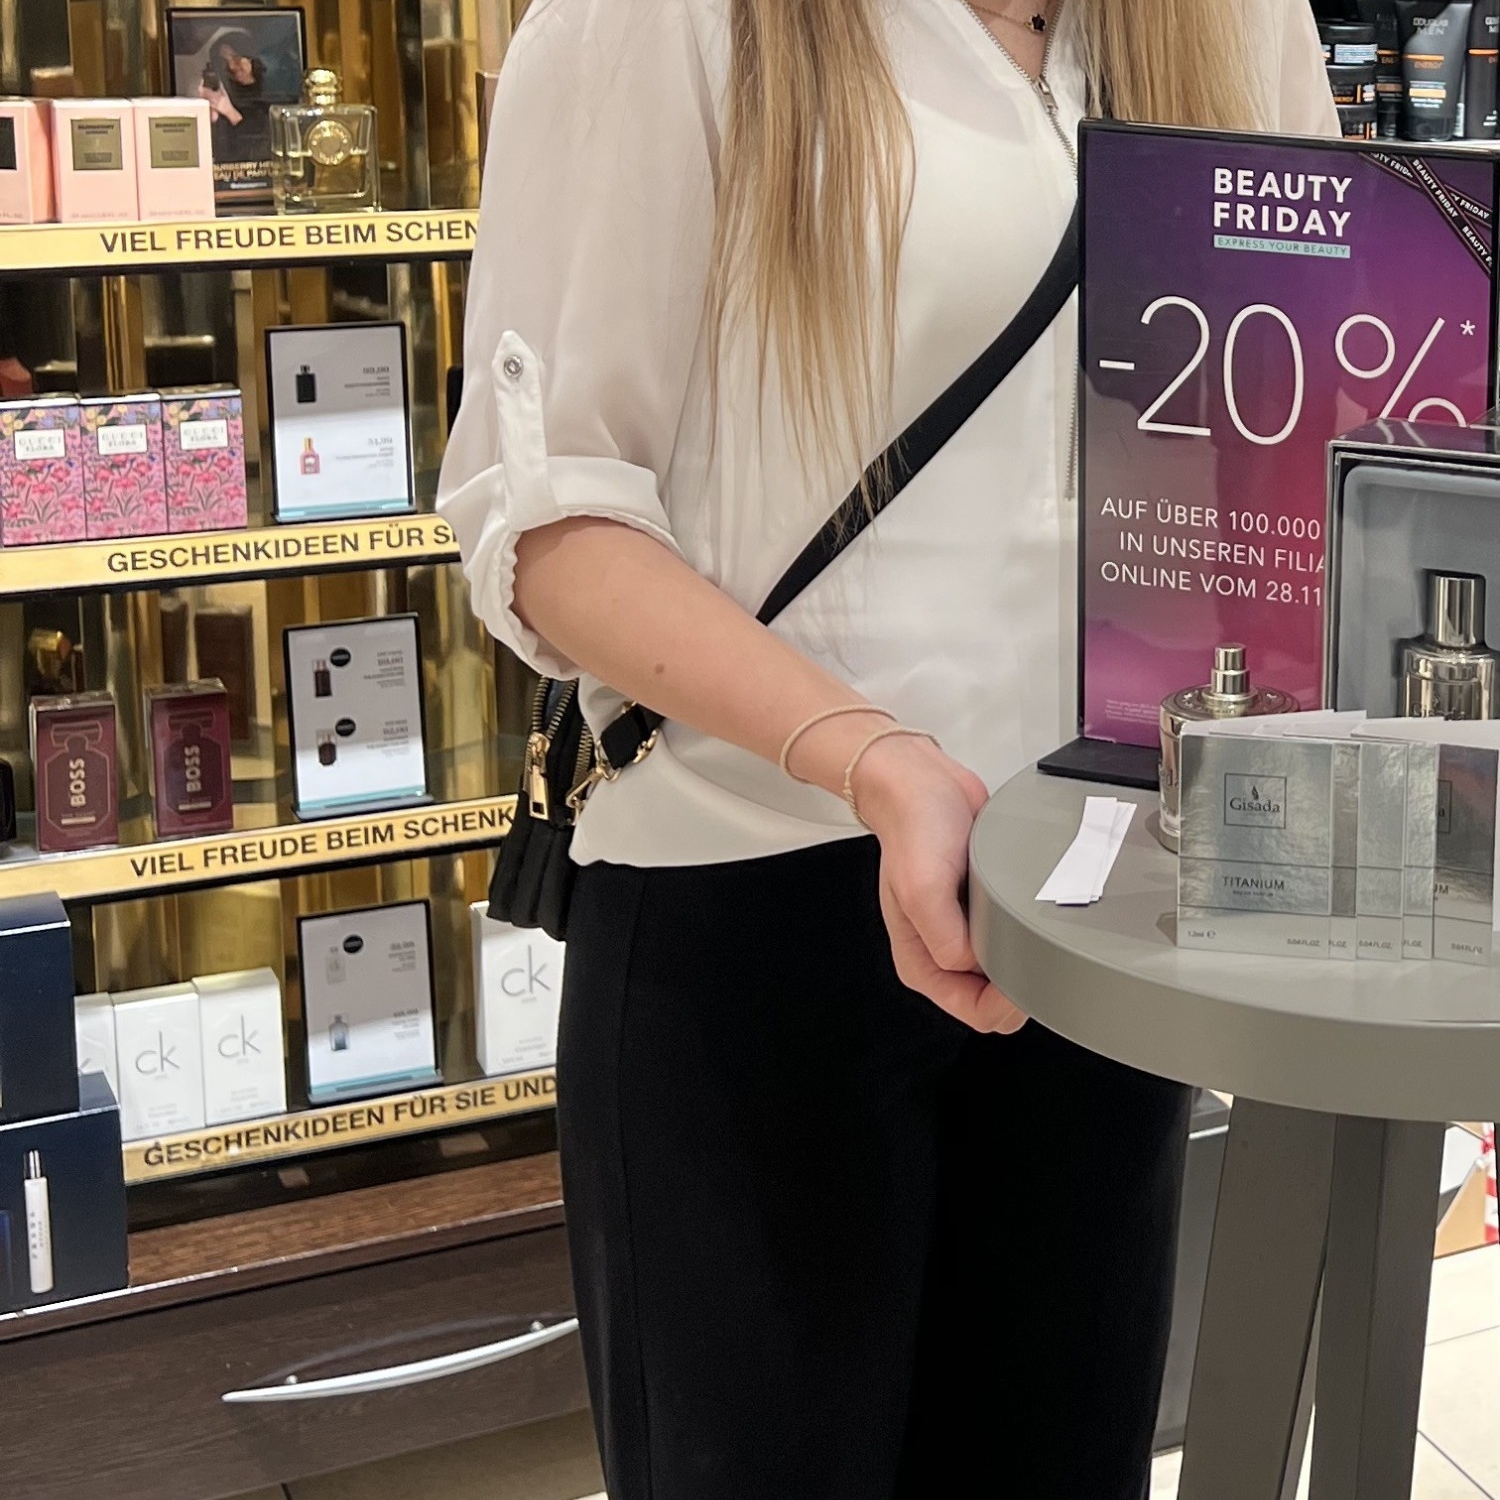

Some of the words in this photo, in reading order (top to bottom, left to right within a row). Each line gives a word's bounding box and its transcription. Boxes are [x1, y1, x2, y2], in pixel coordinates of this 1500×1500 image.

[1417, 26, 1445, 36] MEN
[1214, 167, 1353, 204] BEAUTY
[1412, 158, 1438, 190] BEAUTY
[1435, 189, 1459, 218] FRIDAY
[1462, 225, 1488, 256] BEAUTY
[1214, 200, 1352, 238] FRIDAY
[1459, 199, 1490, 219] FRIDAY
[100, 230, 167, 253] VIEL
[176, 225, 295, 250] FREUDE
[305, 222, 377, 247] BEIM
[1217, 236, 1265, 250] EXPRESS
[1269, 240, 1300, 253] YOUR
[1304, 243, 1348, 257] BEAUTY
[1099, 296, 1305, 445] -20
[1101, 497, 1148, 520] AUF
[1156, 498, 1218, 528] ÜBER
[1229, 510, 1321, 540] 100.000
[107, 533, 360, 573] GESCHENKIDEEN
[369, 523, 425, 550] FÜR
[1119, 531, 1143, 553] IN
[1153, 535, 1265, 567] UNSEREN
[1101, 561, 1192, 591] ONLINE
[1199, 573, 1256, 598] VOM
[1266, 581, 1321, 606] 28.11
[70, 758, 86, 808] BOSS
[186, 745, 201, 794] BOSS
[1229, 797, 1280, 814] Gisada
[130, 854, 194, 878] VIEL
[203, 837, 317, 870] FREUDE
[327, 823, 395, 851] BEIM
[1223, 876, 1285, 890] TITANIUM
[501, 944, 552, 997] ck
[135, 1030, 180, 1075] ck
[218, 1014, 261, 1060] ck
[144, 1109, 386, 1168] GESCHENKIDEEN
[394, 1094, 447, 1124] FÜR
[456, 1086, 496, 1111] SIE
